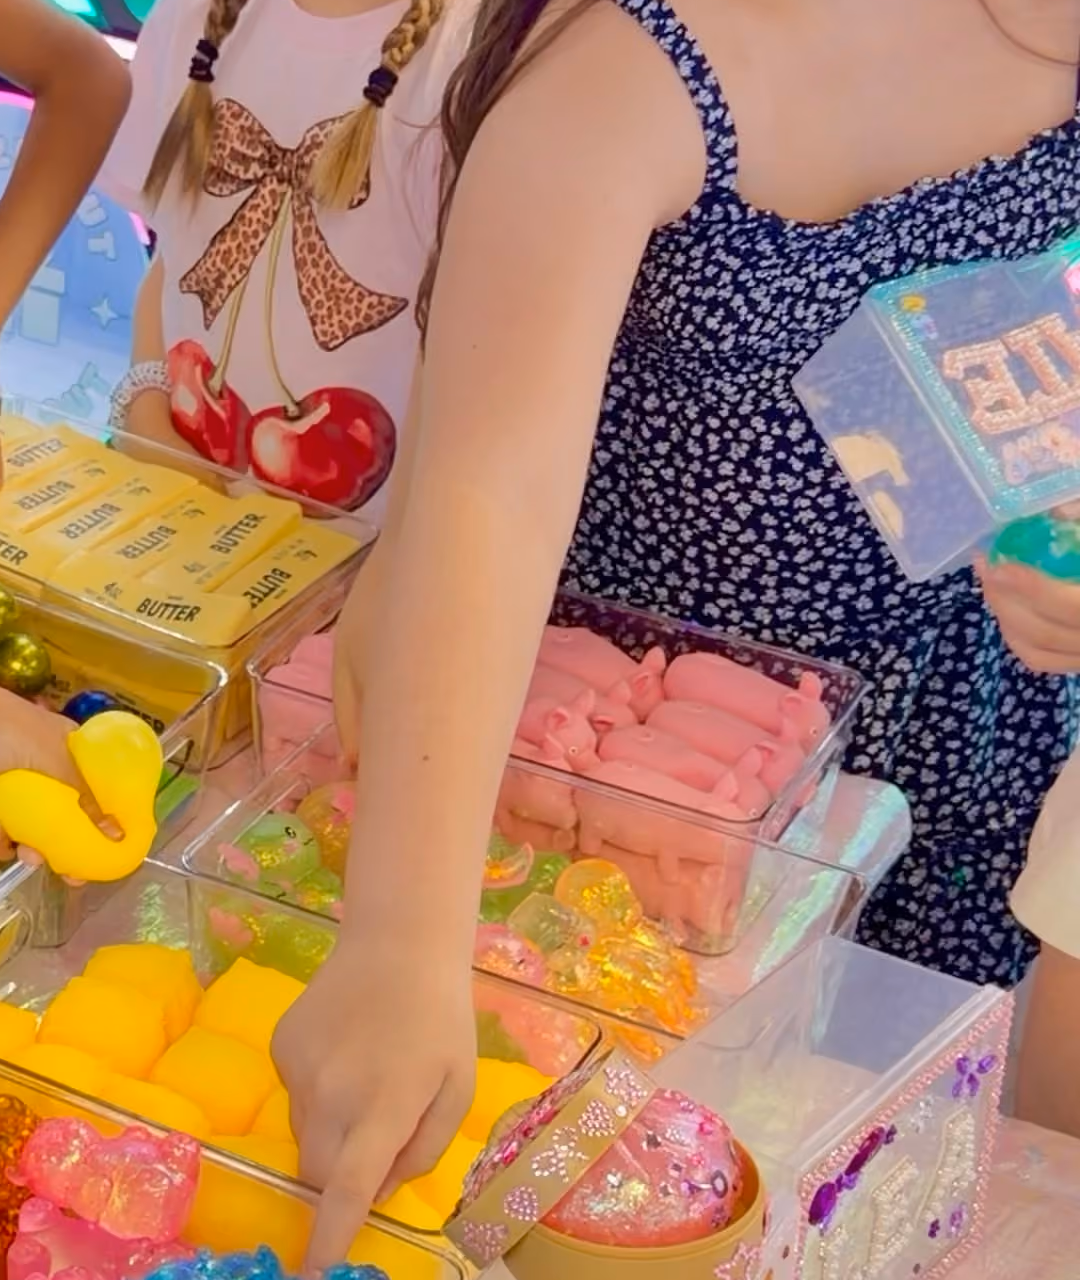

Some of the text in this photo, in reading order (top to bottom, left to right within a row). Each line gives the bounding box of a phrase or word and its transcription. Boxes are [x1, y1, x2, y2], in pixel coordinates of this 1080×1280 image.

[6, 438, 67, 468] BUTTER
[14, 479, 76, 511] BUTTER
[59, 502, 123, 540] BUTTER
[209, 512, 268, 555] BUTTER
[115, 525, 178, 560] BUTTER
[135, 597, 202, 622] BUTTER
